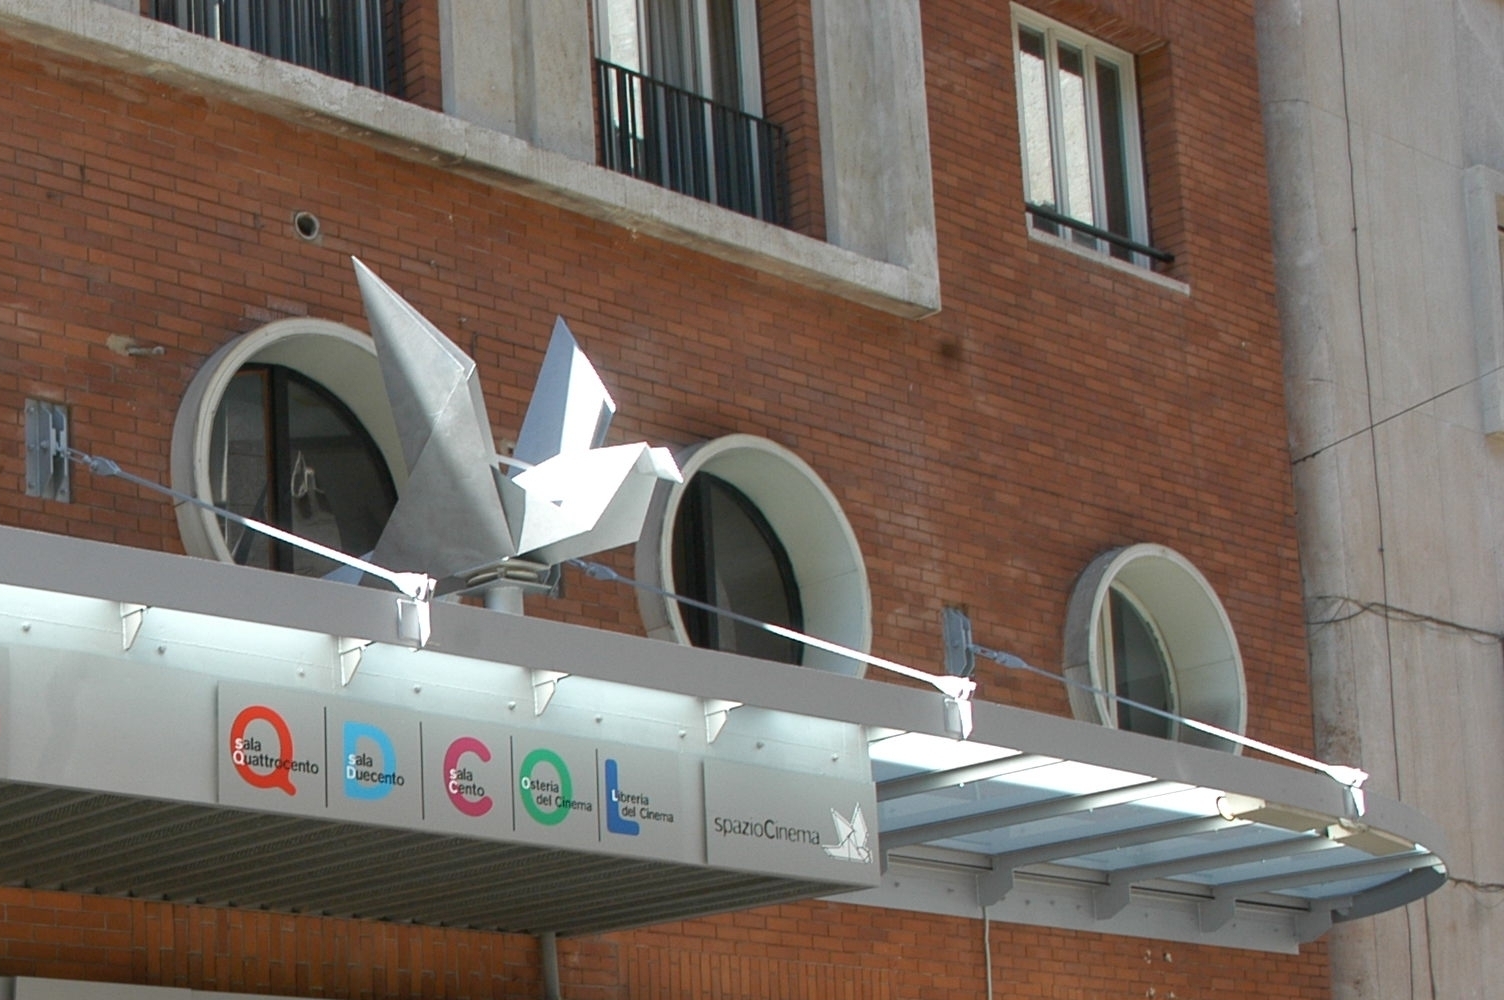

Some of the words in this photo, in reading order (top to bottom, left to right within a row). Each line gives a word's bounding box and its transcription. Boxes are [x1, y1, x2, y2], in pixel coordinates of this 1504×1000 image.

[235, 737, 262, 752] sala
[232, 750, 319, 775] Quattrocento
[348, 752, 373, 767] sala
[346, 766, 405, 786] Duecento
[449, 768, 473, 782] sala
[448, 780, 485, 797] Cento
[521, 776, 560, 793] Osteria
[536, 794, 552, 807] del
[554, 796, 593, 812] Cinema
[611, 789, 649, 806] Libreria
[621, 805, 637, 818] del
[639, 807, 674, 823] Cinema
[713, 815, 821, 846] spazioCinema
